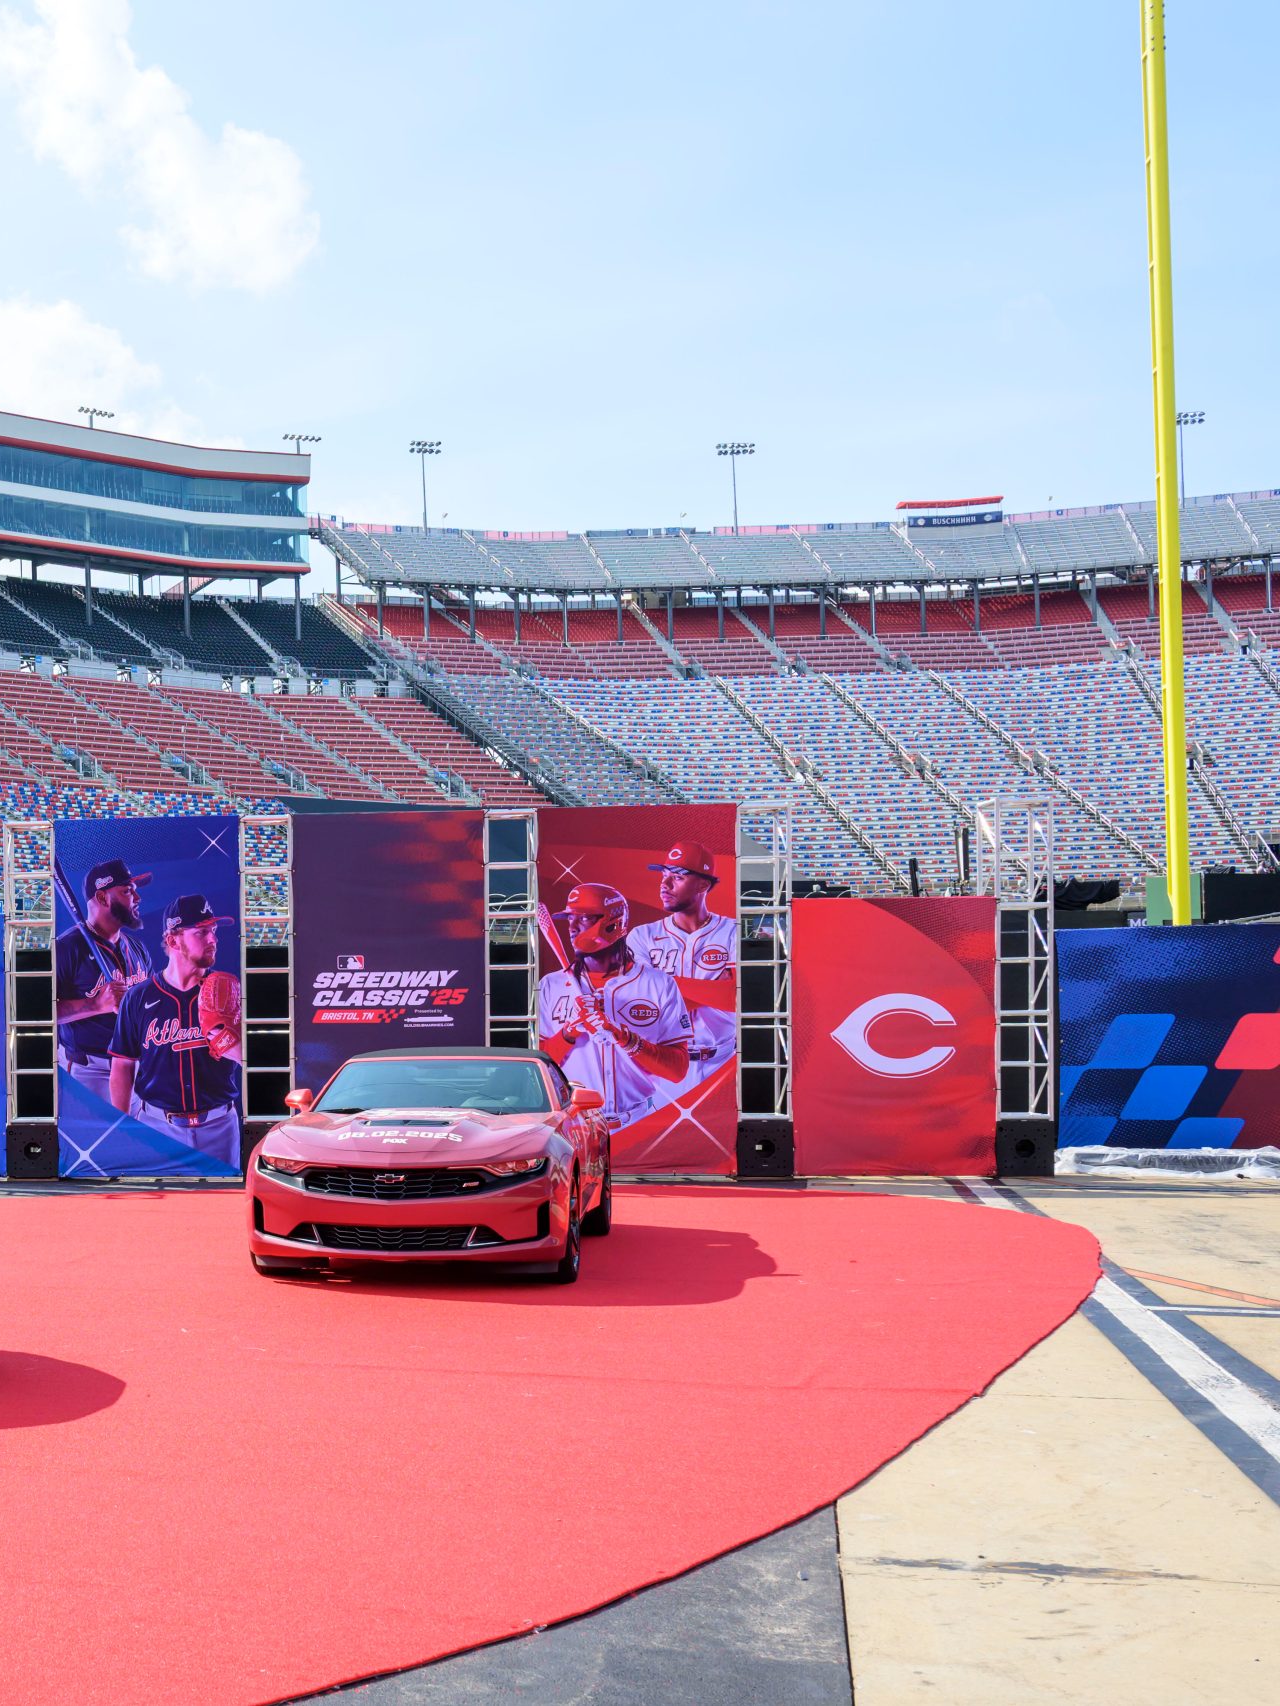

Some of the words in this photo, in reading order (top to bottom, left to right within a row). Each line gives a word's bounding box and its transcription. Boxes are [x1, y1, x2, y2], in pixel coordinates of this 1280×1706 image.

[702, 953, 728, 962] REDS
[312, 970, 459, 989] SPEEDWAY
[312, 989, 429, 1006] CLASSIC
[430, 988, 469, 1006] '25
[321, 1012, 360, 1021] BRISTOL,
[362, 1012, 374, 1020] TN
[630, 1009, 658, 1017] REDS
[142, 1017, 207, 1049] Atlan
[830, 992, 957, 1078] C
[337, 1130, 463, 1143] 08.02.2025
